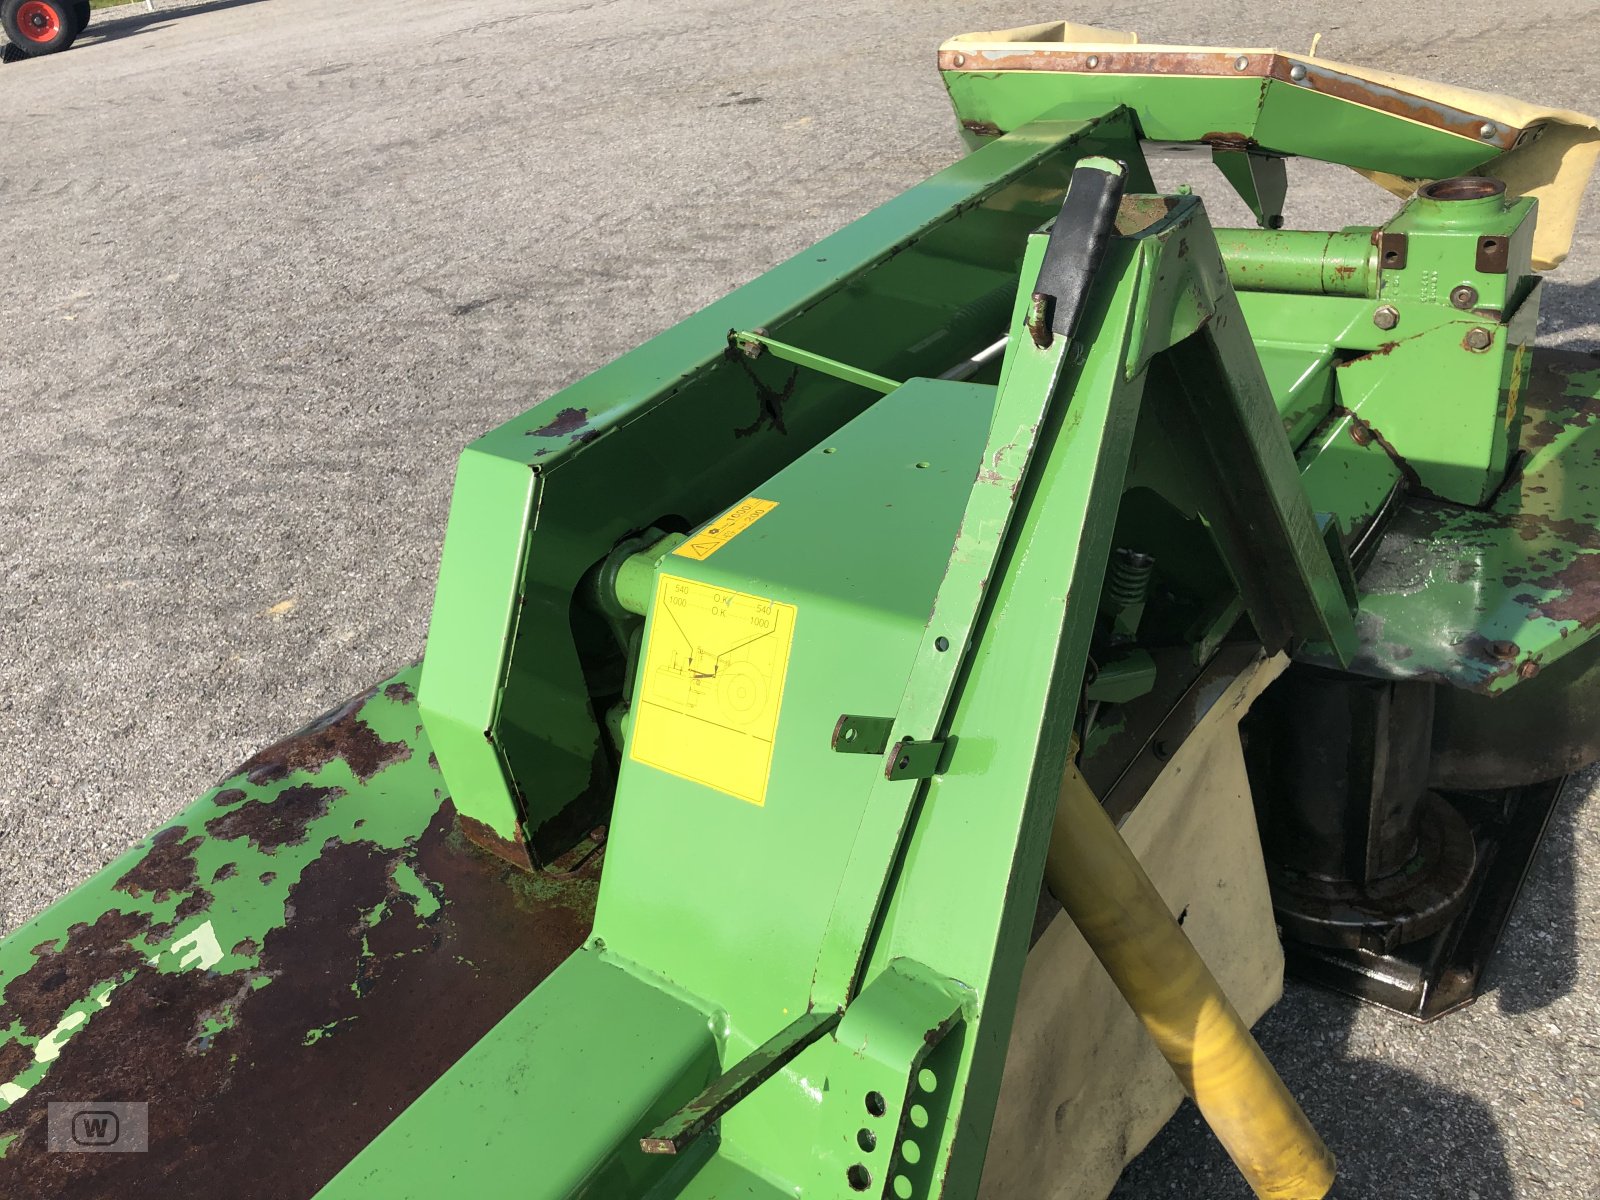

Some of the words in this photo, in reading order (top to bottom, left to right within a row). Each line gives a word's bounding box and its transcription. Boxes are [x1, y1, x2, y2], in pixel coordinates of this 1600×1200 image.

[669, 596, 687, 607] 1000
[750, 616, 770, 628] 1000
[675, 584, 689, 595] 540
[756, 604, 772, 615] 540
